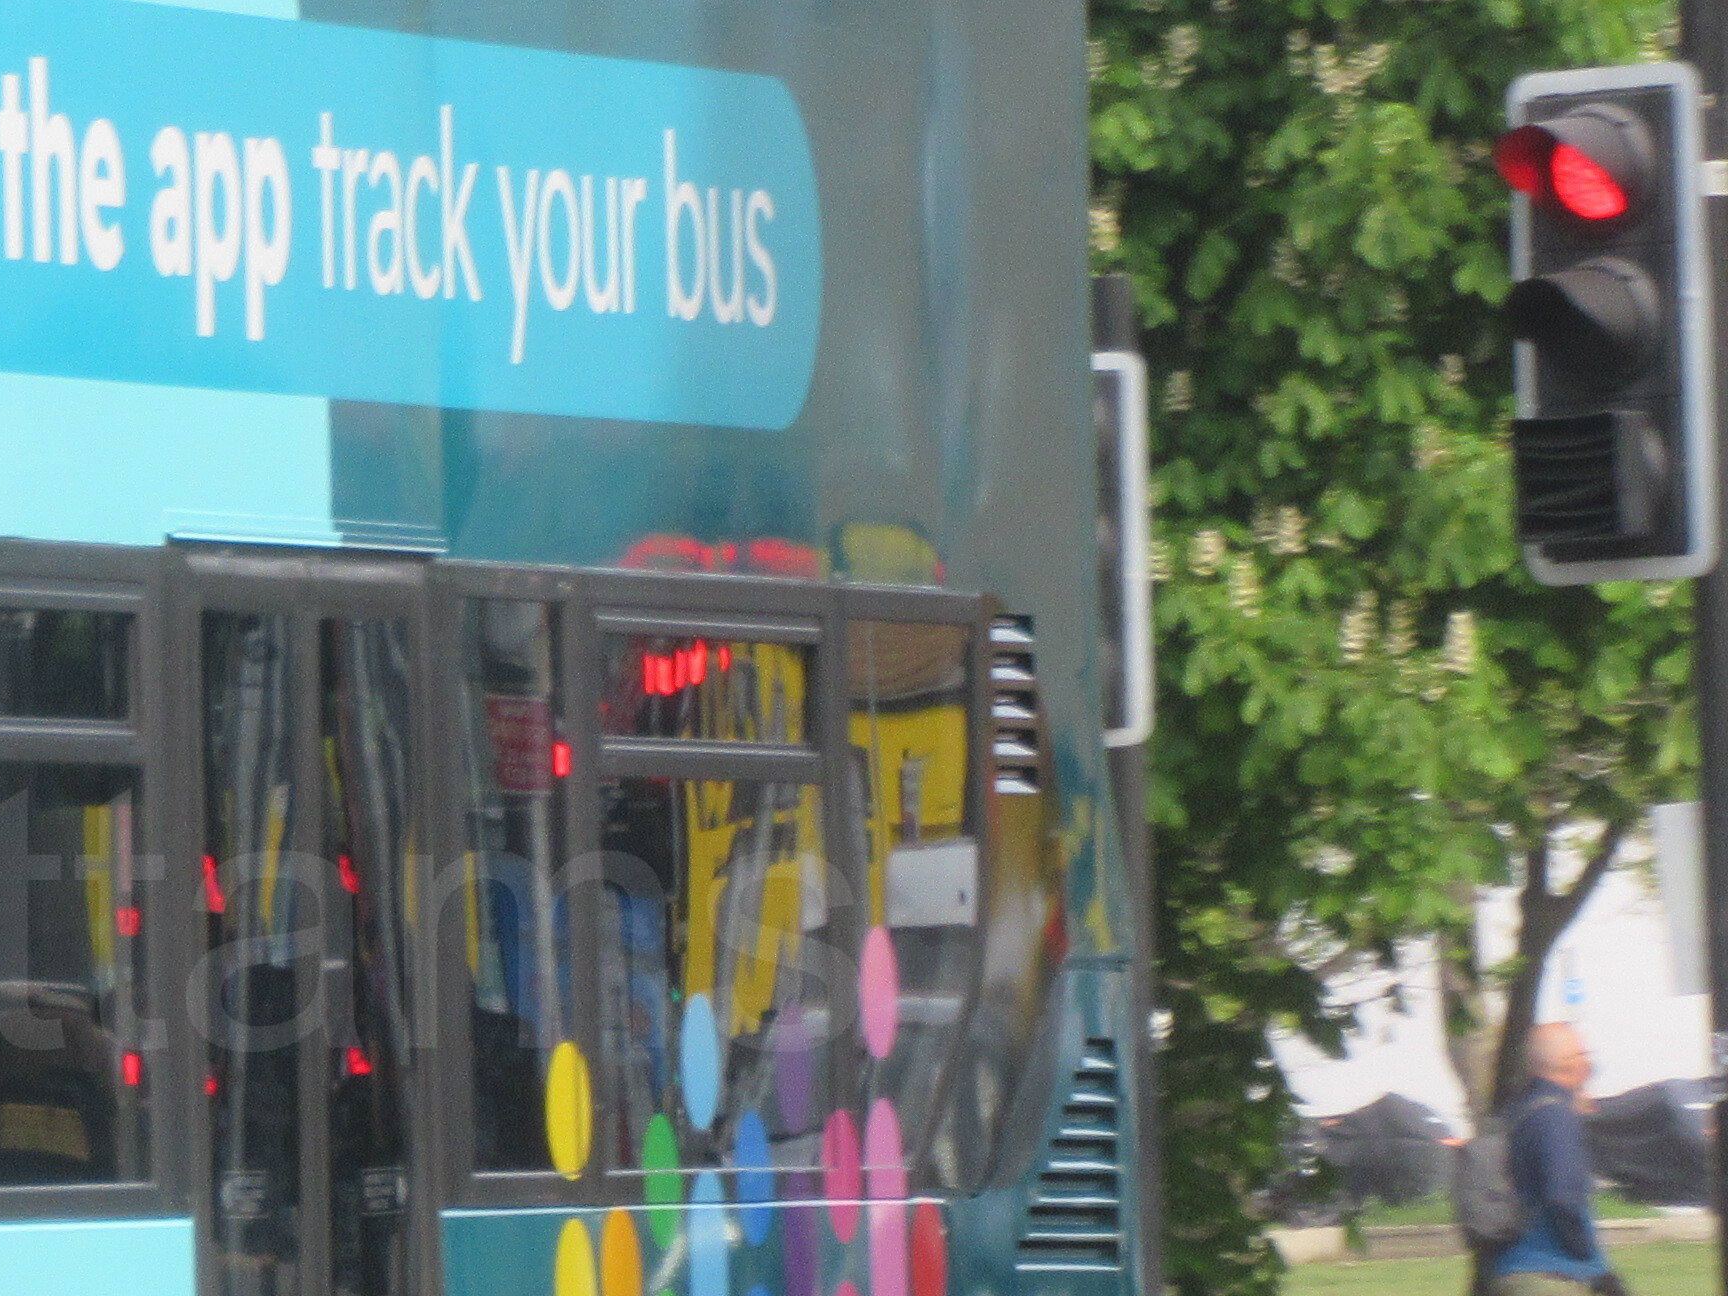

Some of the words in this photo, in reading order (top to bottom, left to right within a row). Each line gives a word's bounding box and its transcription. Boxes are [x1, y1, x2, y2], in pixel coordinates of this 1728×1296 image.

[150, 126, 291, 341] app
[312, 104, 482, 302] track
[497, 164, 647, 364] your
[662, 128, 777, 328] bus
